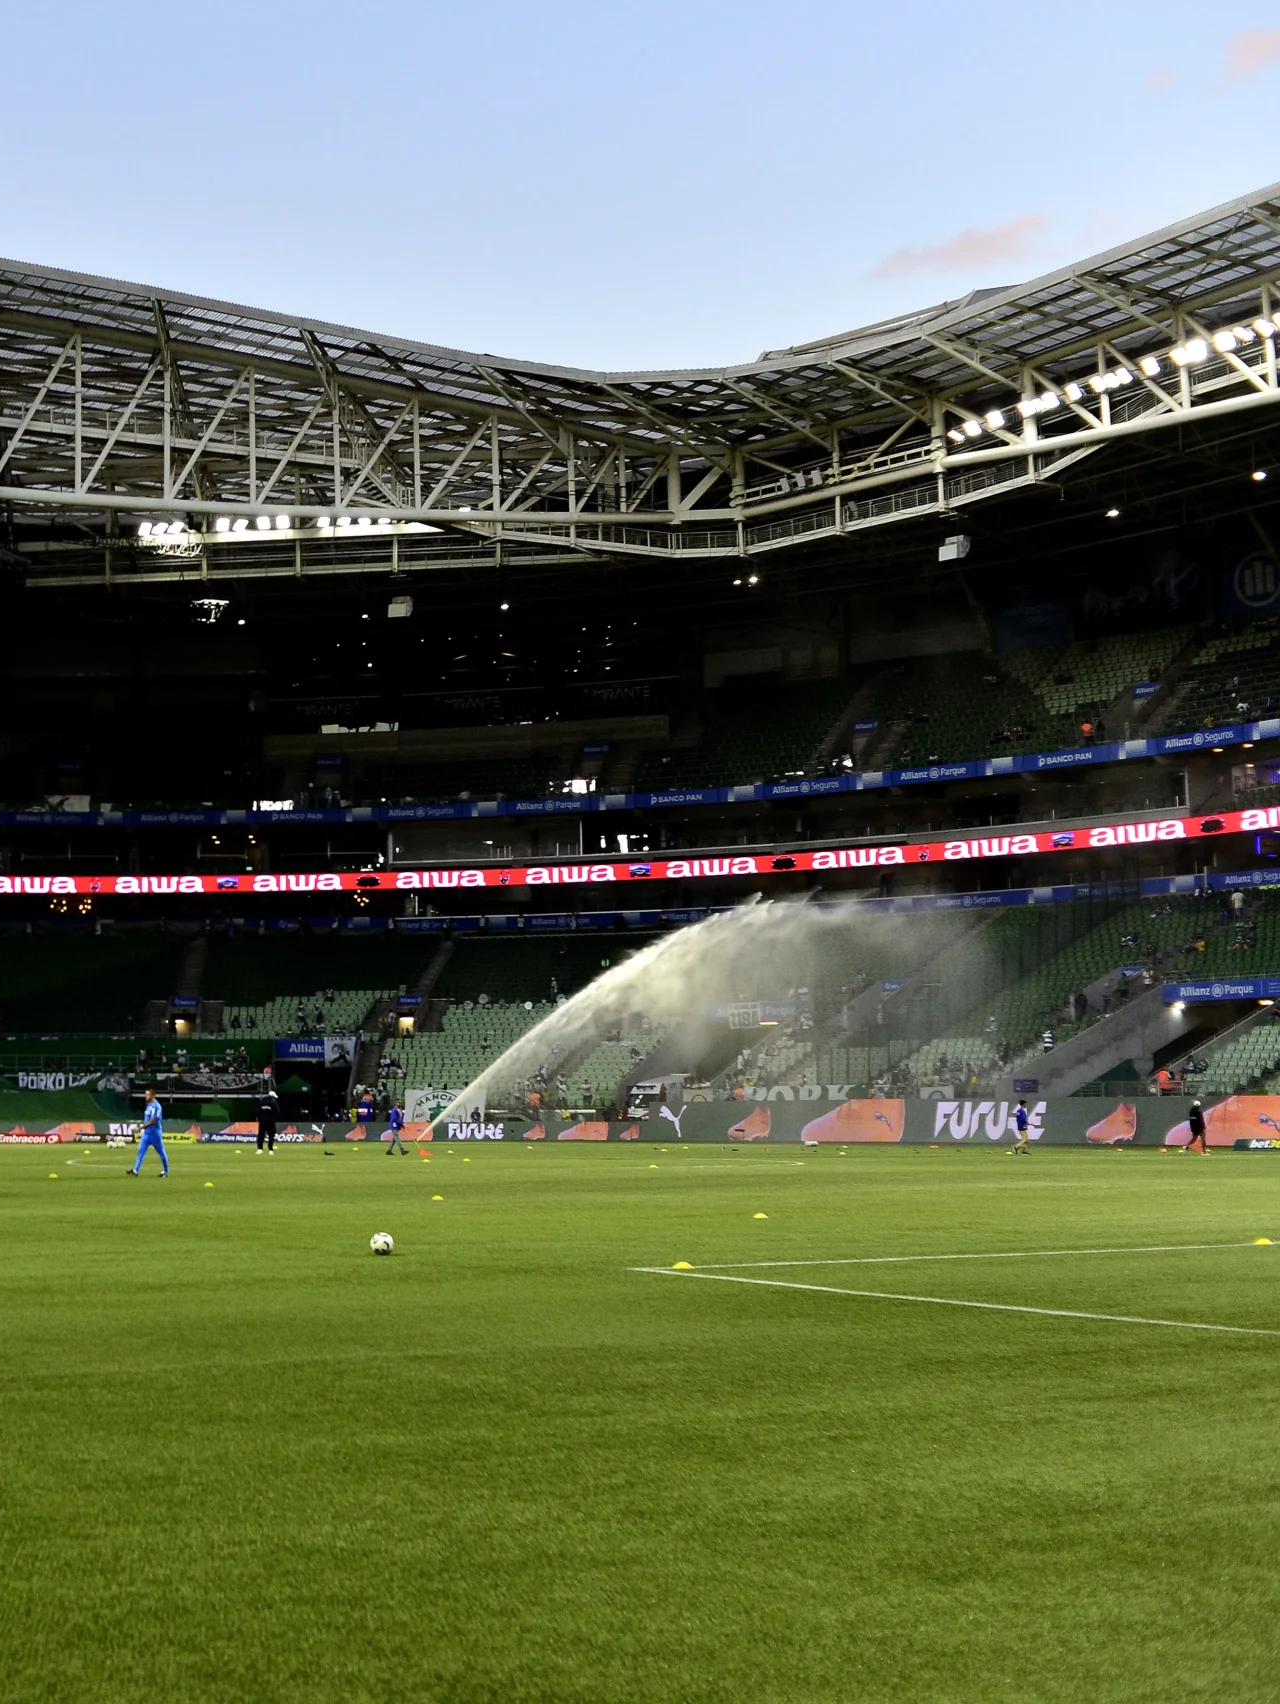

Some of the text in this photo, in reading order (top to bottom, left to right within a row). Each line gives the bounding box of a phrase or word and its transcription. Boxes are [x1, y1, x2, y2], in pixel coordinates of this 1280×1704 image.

[1165, 731, 1234, 749] Allianz Seguros
[1046, 752, 1093, 765] BANCO PAN
[900, 767, 967, 781] Allianz Parque
[772, 781, 840, 795] Allianz Seguros
[516, 800, 581, 811] Allianz Parque
[658, 793, 703, 804] BANCO PAN
[141, 814, 167, 822] Allianz
[279, 813, 306, 821] BANCO
[388, 807, 455, 817] Allianz Seguros
[1089, 820, 1186, 846] aiwa
[943, 834, 1039, 859] aiwa
[811, 846, 906, 869] aiwa
[524, 863, 617, 886] aiwa
[665, 856, 758, 879] aiwa
[115, 875, 204, 894] aiwa
[252, 872, 343, 893] aiwa
[395, 867, 486, 890] aiwa
[1225, 876, 1253, 885] Allianz
[936, 896, 1001, 907] Allianz Seguros
[531, 917, 557, 925] Allianz
[1180, 986, 1211, 998] Allianz
[1224, 984, 1255, 995] Parque
[447, 1123, 504, 1140] FUTURE
